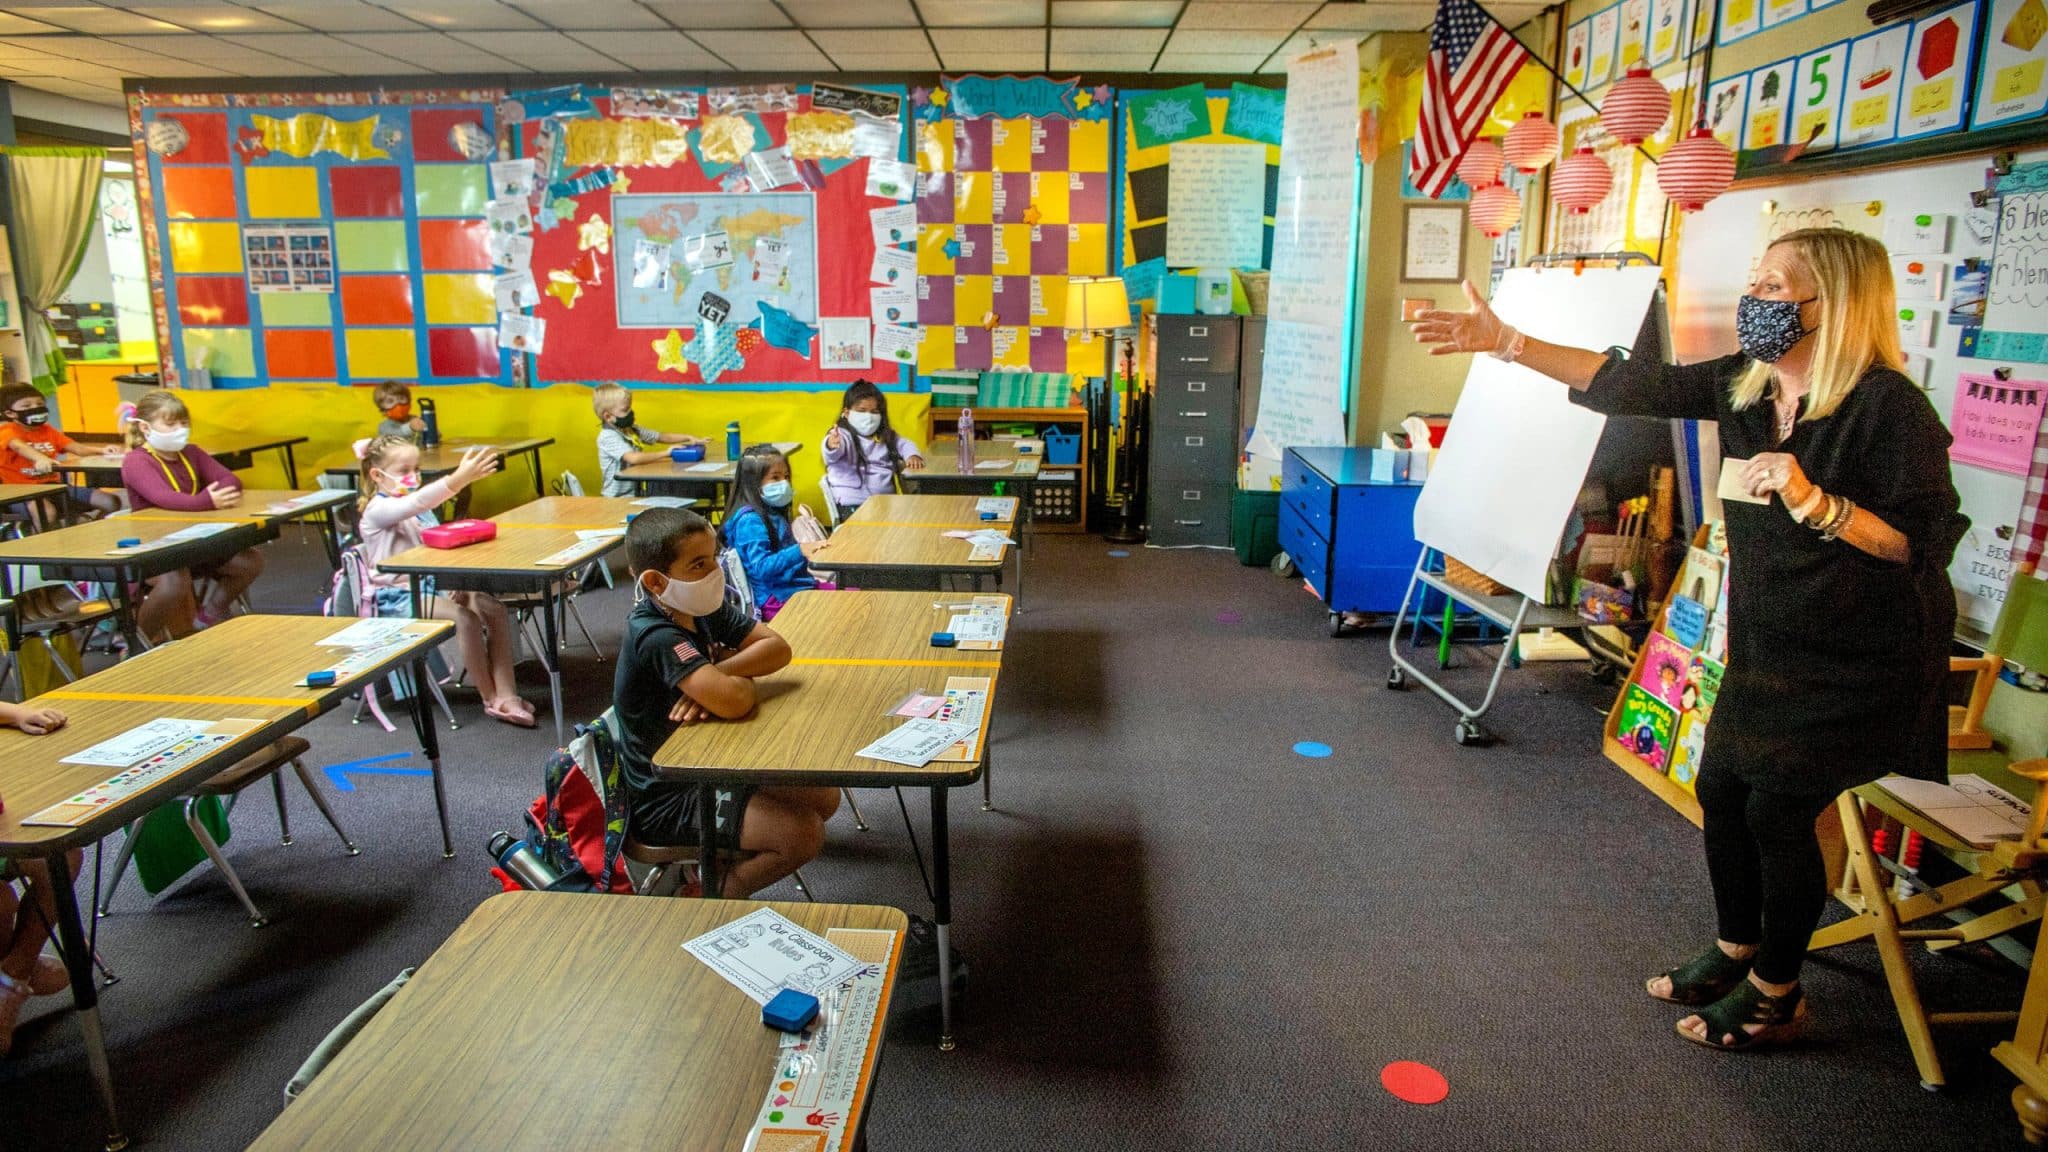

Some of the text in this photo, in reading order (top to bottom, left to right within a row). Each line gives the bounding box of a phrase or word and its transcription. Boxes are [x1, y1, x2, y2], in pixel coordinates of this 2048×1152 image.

[1807, 54, 1831, 106] 5
[1156, 110, 1179, 126] Our
[714, 241, 728, 258] yet
[1906, 277, 1927, 286] move
[700, 301, 726, 326] YET
[767, 937, 806, 963] Rules
[769, 922, 835, 964] Our Classroom
